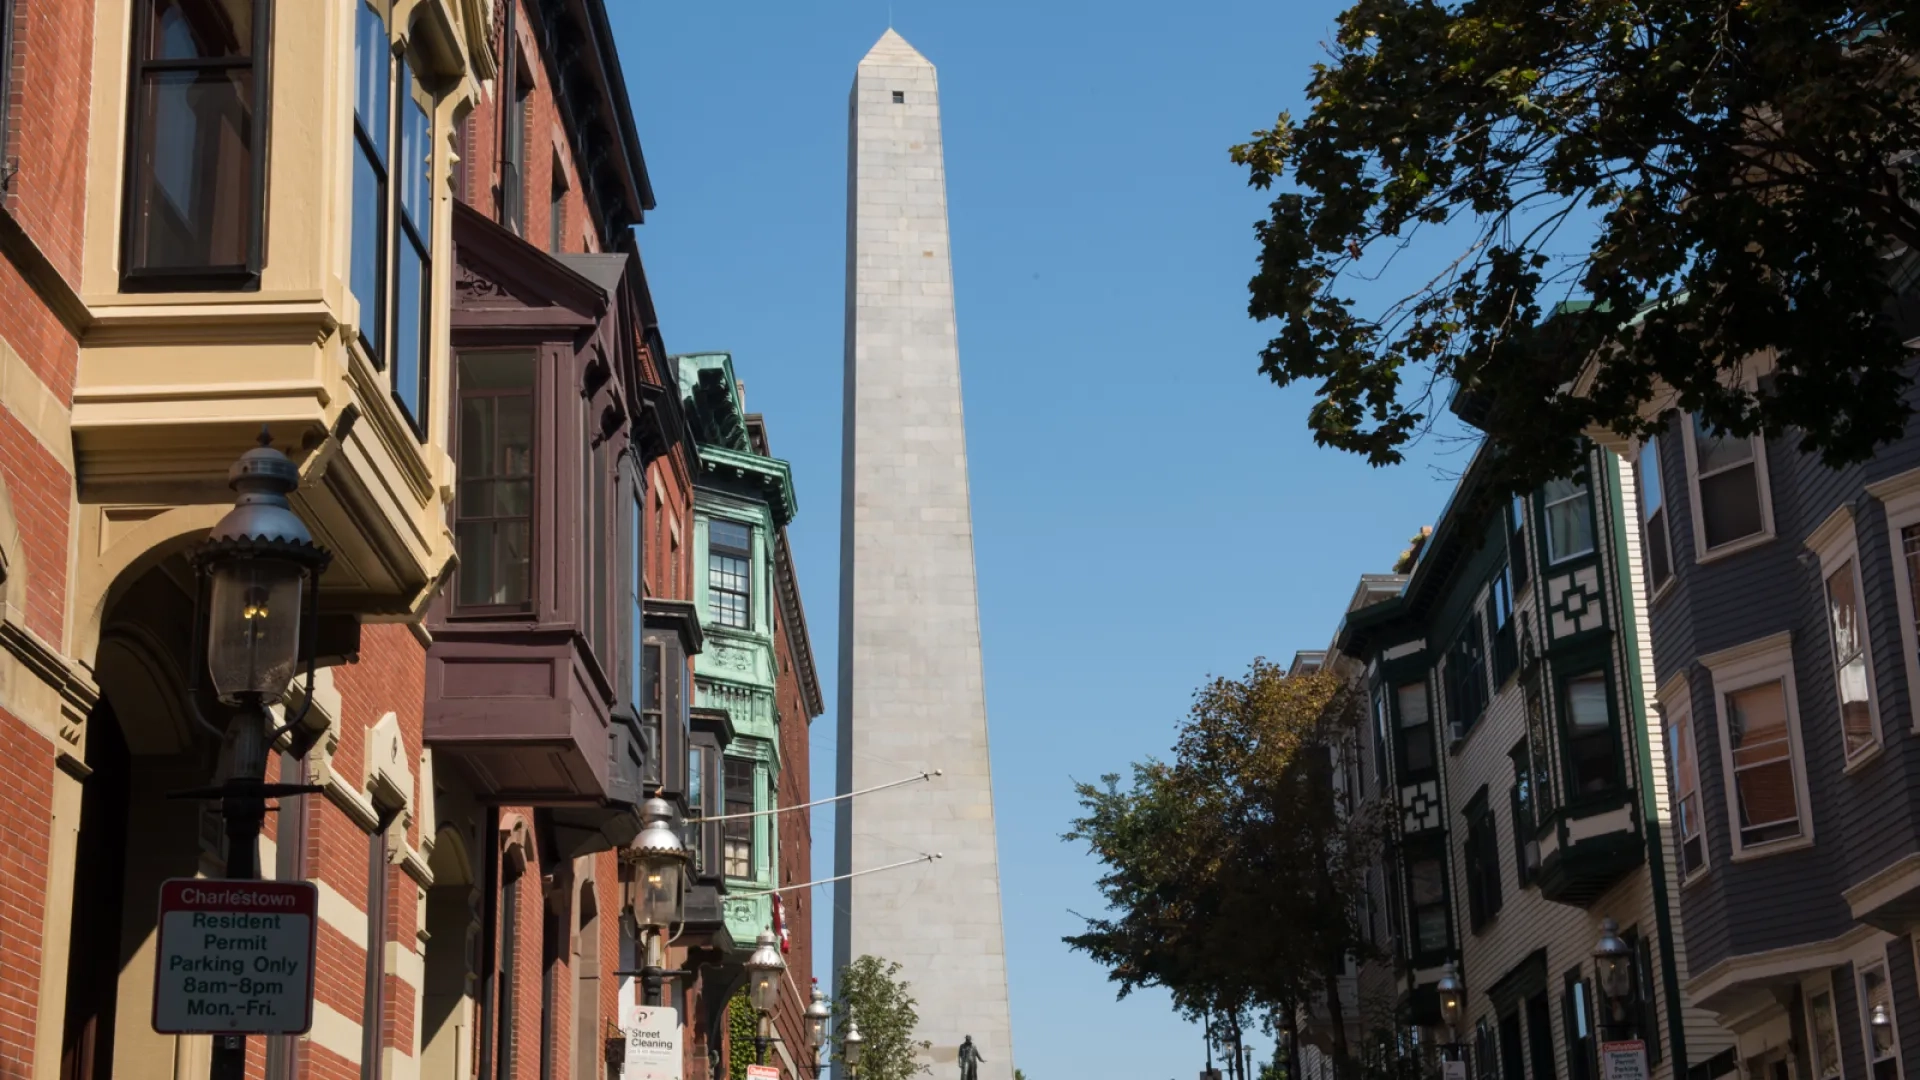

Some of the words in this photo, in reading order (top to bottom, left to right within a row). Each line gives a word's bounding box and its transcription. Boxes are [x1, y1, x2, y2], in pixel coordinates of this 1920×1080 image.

[181, 888, 296, 906] Charlestown
[192, 912, 281, 929] Resident
[203, 934, 268, 950] Permit
[169, 955, 244, 975] Parking
[253, 956, 298, 976] Only
[183, 976, 283, 996] 8am-8pm
[187, 999, 277, 1016] Mon.-Fri.
[631, 1029, 660, 1038] Street
[631, 1038, 673, 1050] Cleaning
